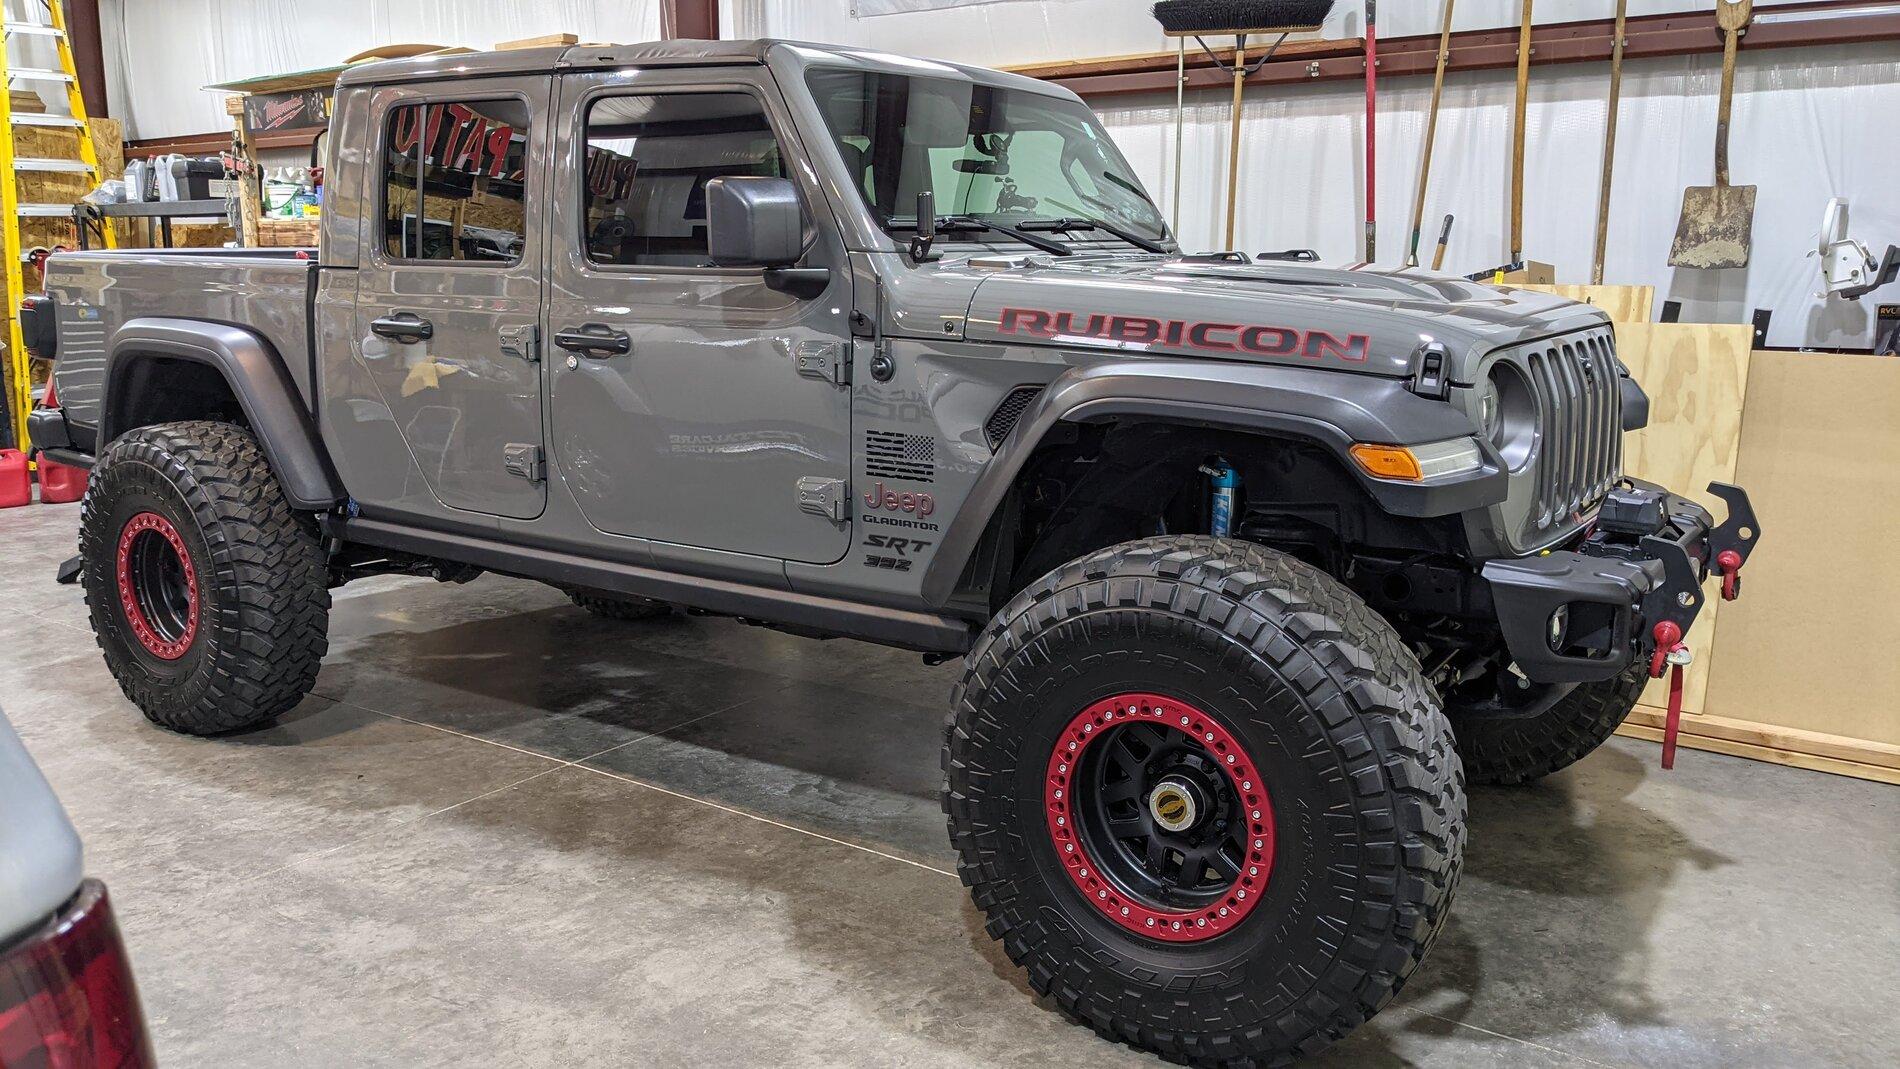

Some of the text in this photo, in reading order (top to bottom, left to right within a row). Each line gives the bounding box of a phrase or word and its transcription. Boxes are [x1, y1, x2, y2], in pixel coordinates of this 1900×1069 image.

[999, 307, 1370, 361] RUBICON
[864, 482, 935, 519] Jeep
[862, 514, 940, 531] GLADIATOR
[862, 534, 933, 557] SRT
[863, 554, 912, 572] 392
